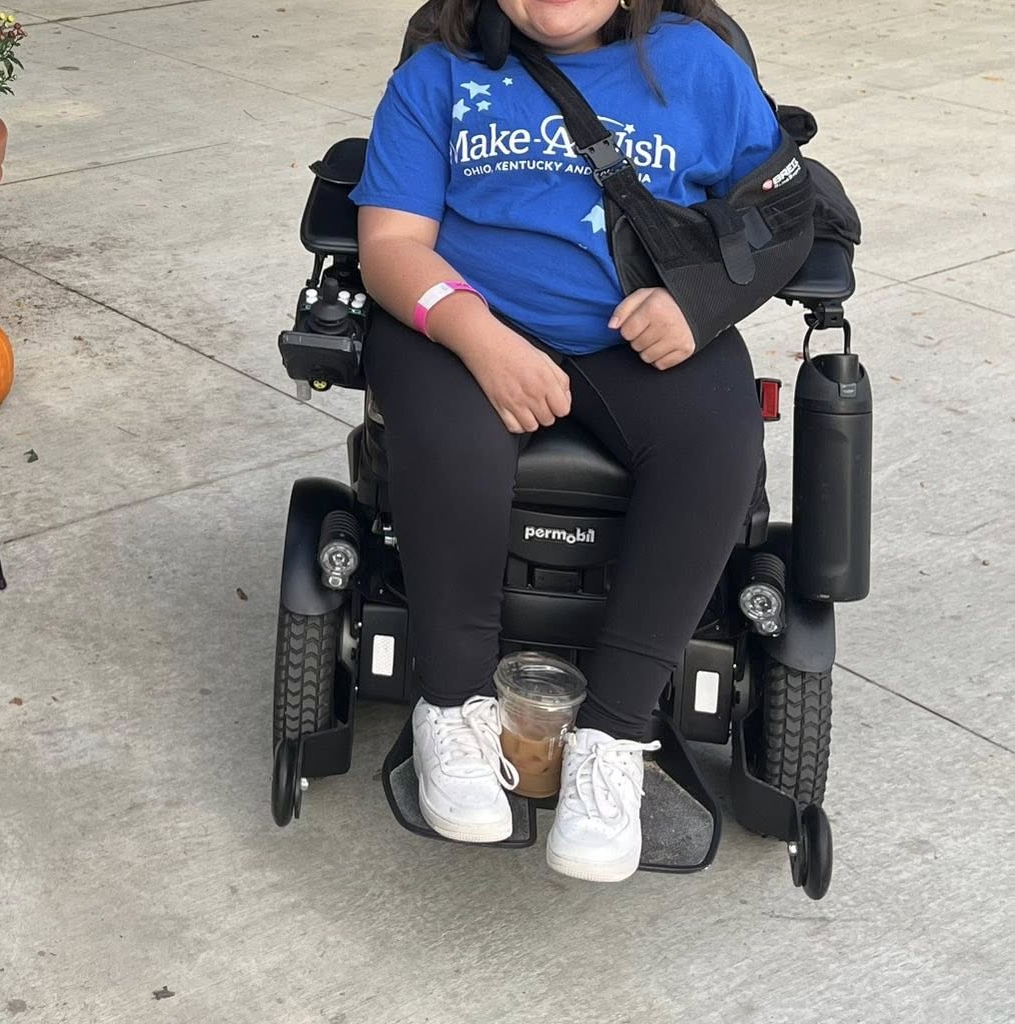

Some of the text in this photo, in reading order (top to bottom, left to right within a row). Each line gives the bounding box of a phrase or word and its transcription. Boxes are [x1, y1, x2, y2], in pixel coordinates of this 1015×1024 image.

[463, 164, 494, 176] OHIO,
[495, 160, 563, 172] KENTUCKY
[565, 164, 593, 176] AND
[524, 526, 595, 544] permobil
